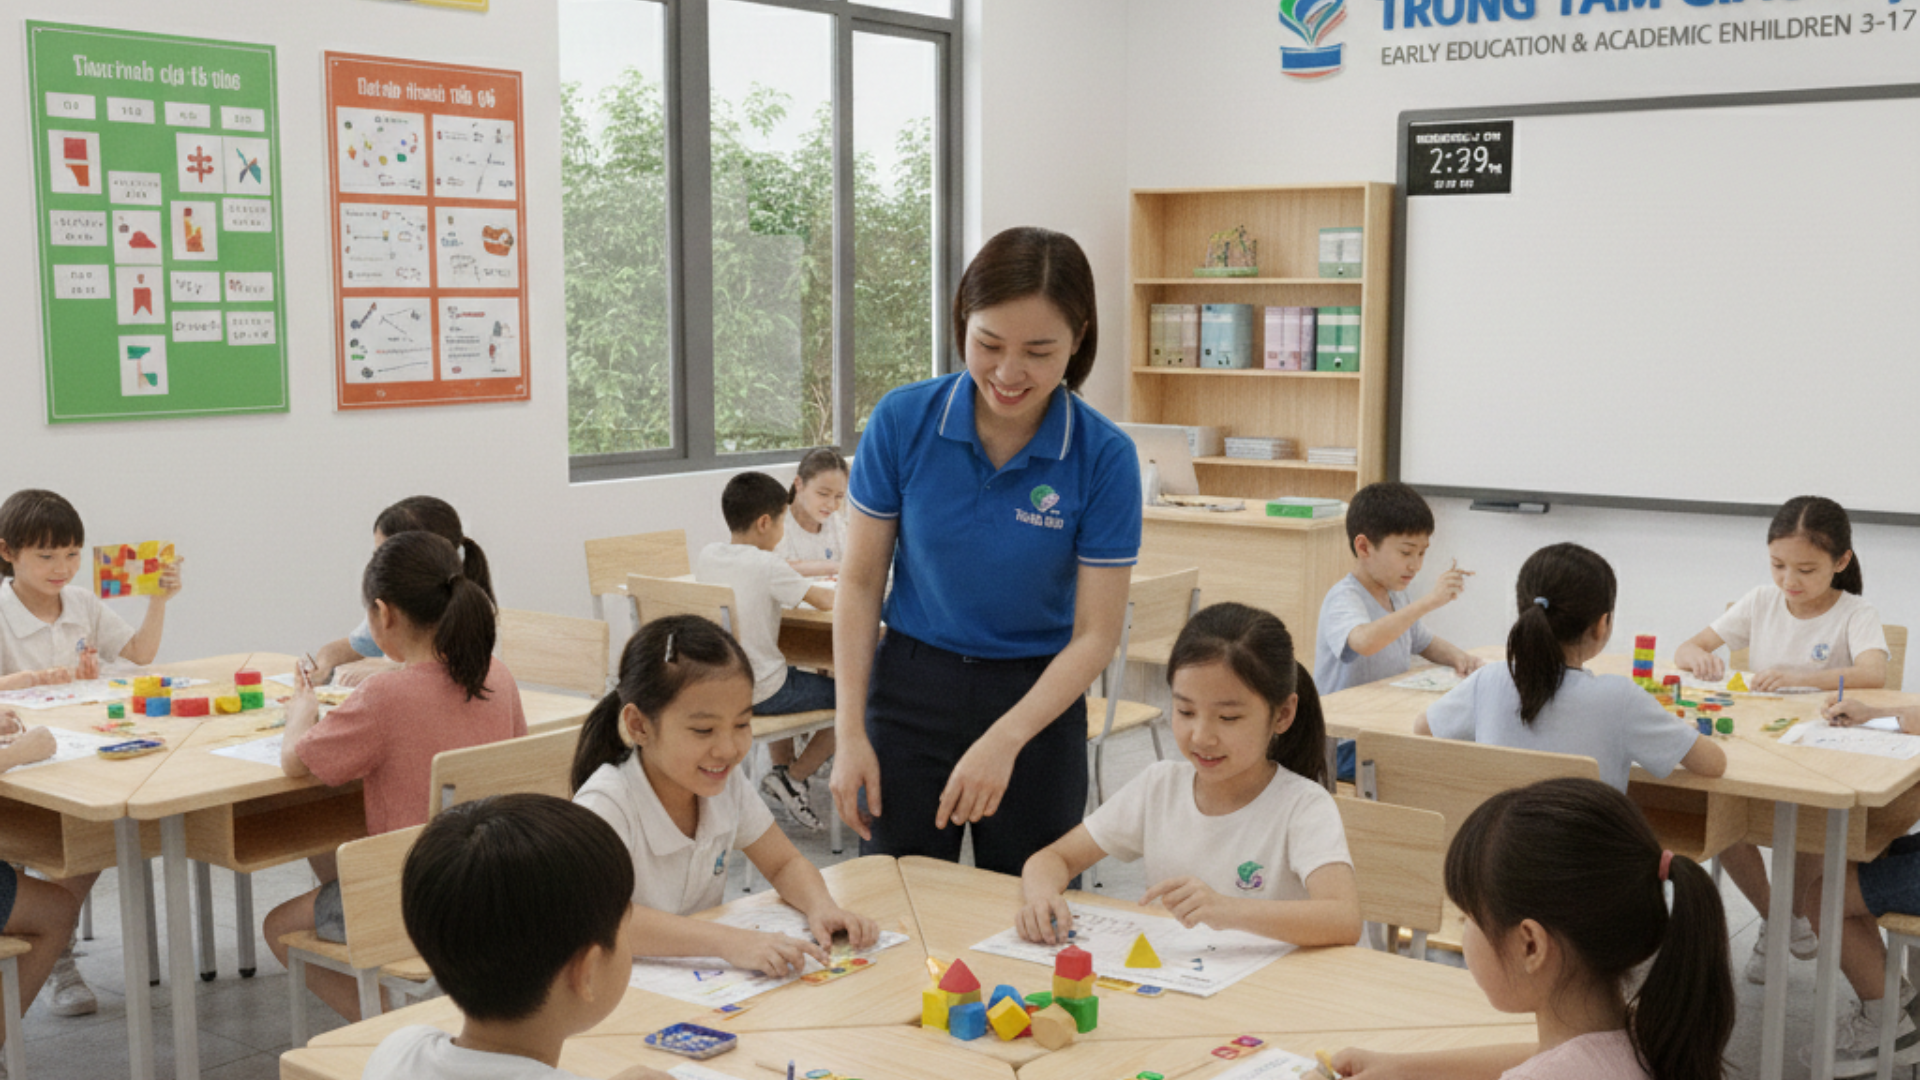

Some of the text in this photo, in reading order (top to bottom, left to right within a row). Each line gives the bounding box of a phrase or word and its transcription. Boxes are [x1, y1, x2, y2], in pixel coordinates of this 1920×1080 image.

[1381, 9, 1917, 65] EARLY EDUCATION & ACADEMIC ENHILDREN 3-17
